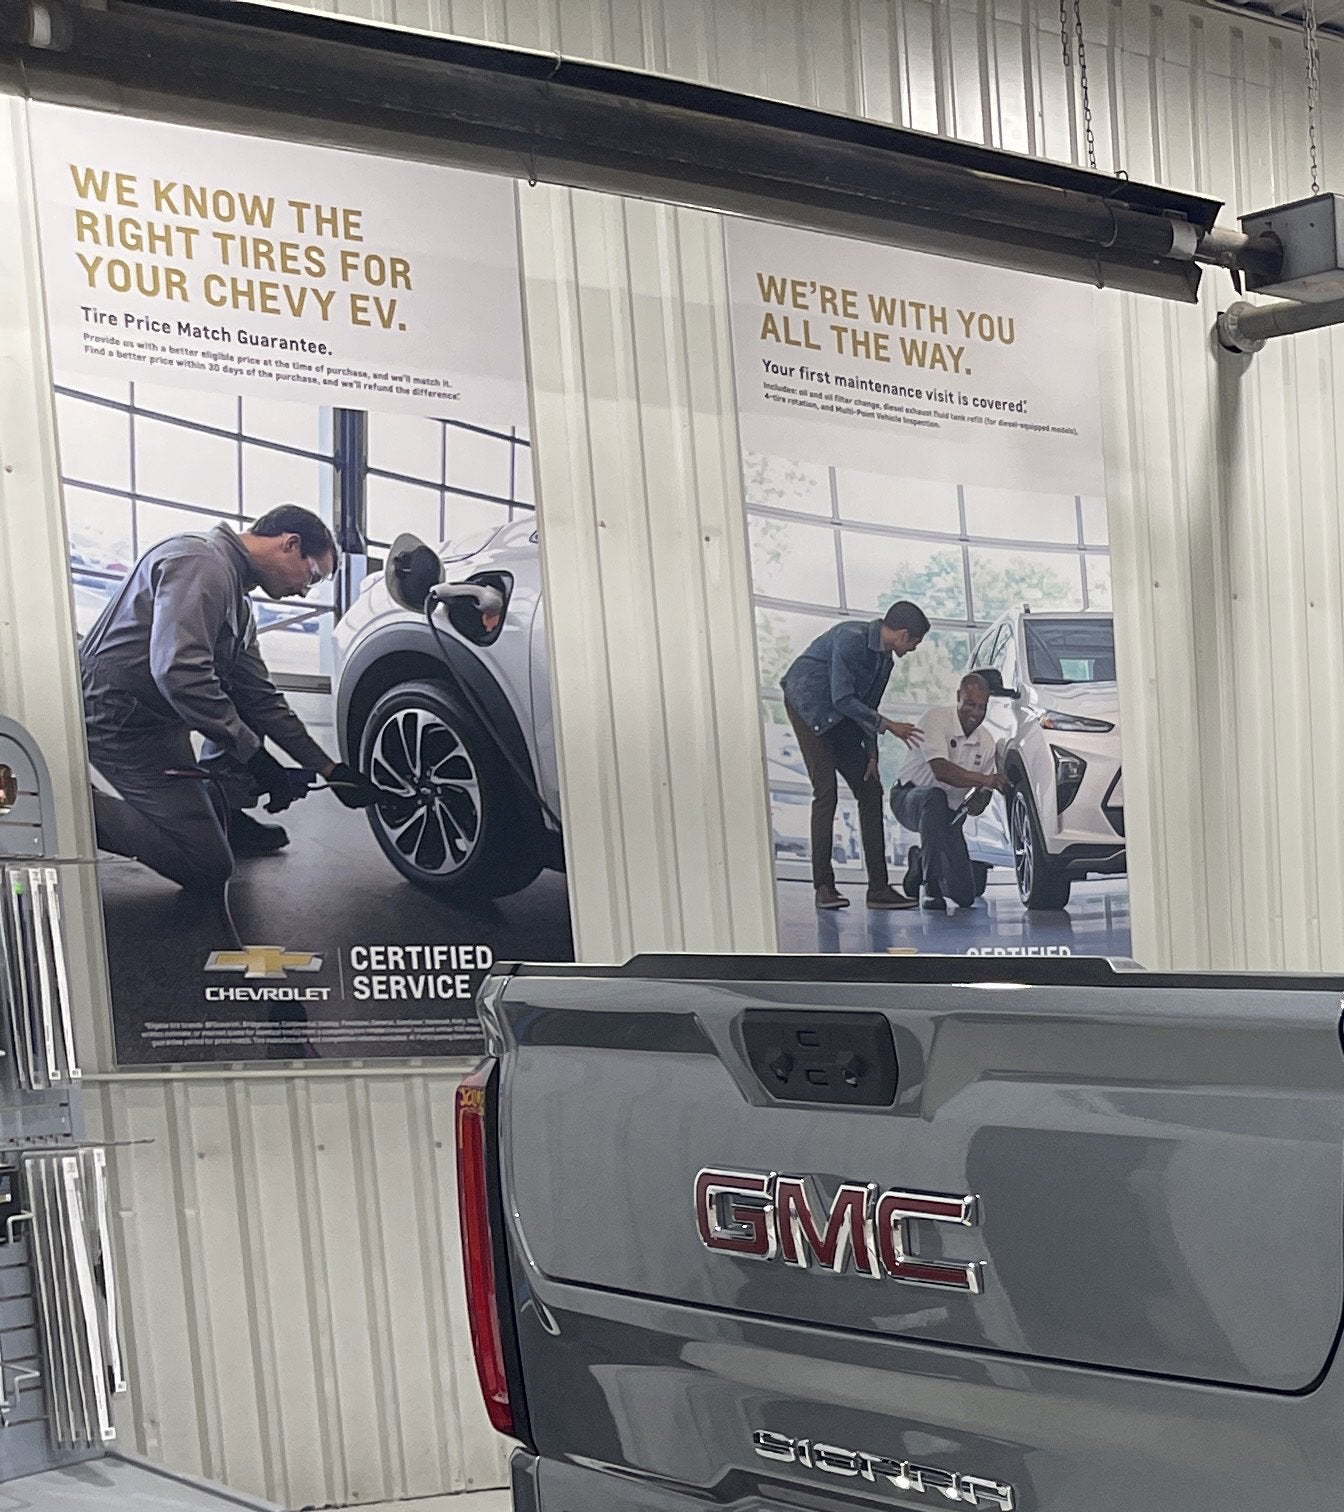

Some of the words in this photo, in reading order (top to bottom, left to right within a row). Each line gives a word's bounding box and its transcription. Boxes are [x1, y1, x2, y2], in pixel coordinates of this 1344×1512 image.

[70, 164, 139, 208] WE
[154, 179, 275, 228] KNOW
[288, 200, 363, 242] THE
[75, 208, 199, 260] RIGHT
[212, 231, 326, 278] TIRES
[340, 250, 413, 291] FOR
[75, 252, 190, 302] YOUR
[203, 273, 336, 321] CHEVY
[350, 293, 407, 331] EV.
[756, 272, 859, 320] WE'RE
[867, 293, 948, 335] WITH
[956, 309, 1015, 345] YOU
[80, 306, 118, 326] Tire
[124, 313, 171, 334] Price
[177, 321, 231, 343] Match
[237, 329, 333, 355] Guarantee.
[83, 332, 120, 346] Provide
[123, 340, 134, 348] us
[137, 341, 159, 351] with
[160, 345, 166, 353] a
[169, 345, 199, 358] better
[201, 350, 234, 364] eligible
[237, 355, 261, 367] price
[263, 358, 273, 367] at
[274, 359, 290, 369] the
[292, 361, 313, 372] time
[314, 364, 324, 373] of
[373, 372, 389, 381] and
[413, 377, 441, 387] match
[760, 312, 822, 352] ALL
[830, 324, 891, 363] THE
[899, 336, 972, 376] WAY.
[84, 345, 106, 357] Find
[116, 350, 147, 362] better
[149, 356, 174, 367] price
[176, 359, 206, 371] within
[222, 365, 244, 376] days
[246, 368, 256, 377] of
[258, 369, 273, 379] the
[322, 377, 339, 387] and
[363, 382, 393, 394] refund
[395, 386, 410, 395] the
[762, 359, 796, 377] Your
[798, 365, 831, 385] first
[834, 374, 923, 400] maintenance
[925, 387, 955, 405] visit
[958, 391, 969, 406] is
[350, 945, 493, 970] CERTIFIED
[353, 974, 472, 1000] SERVICE
[205, 987, 331, 1001] CHEVROLET
[693, 1164, 987, 1293] GMC
[752, 1429, 1016, 1512] SIERRA
